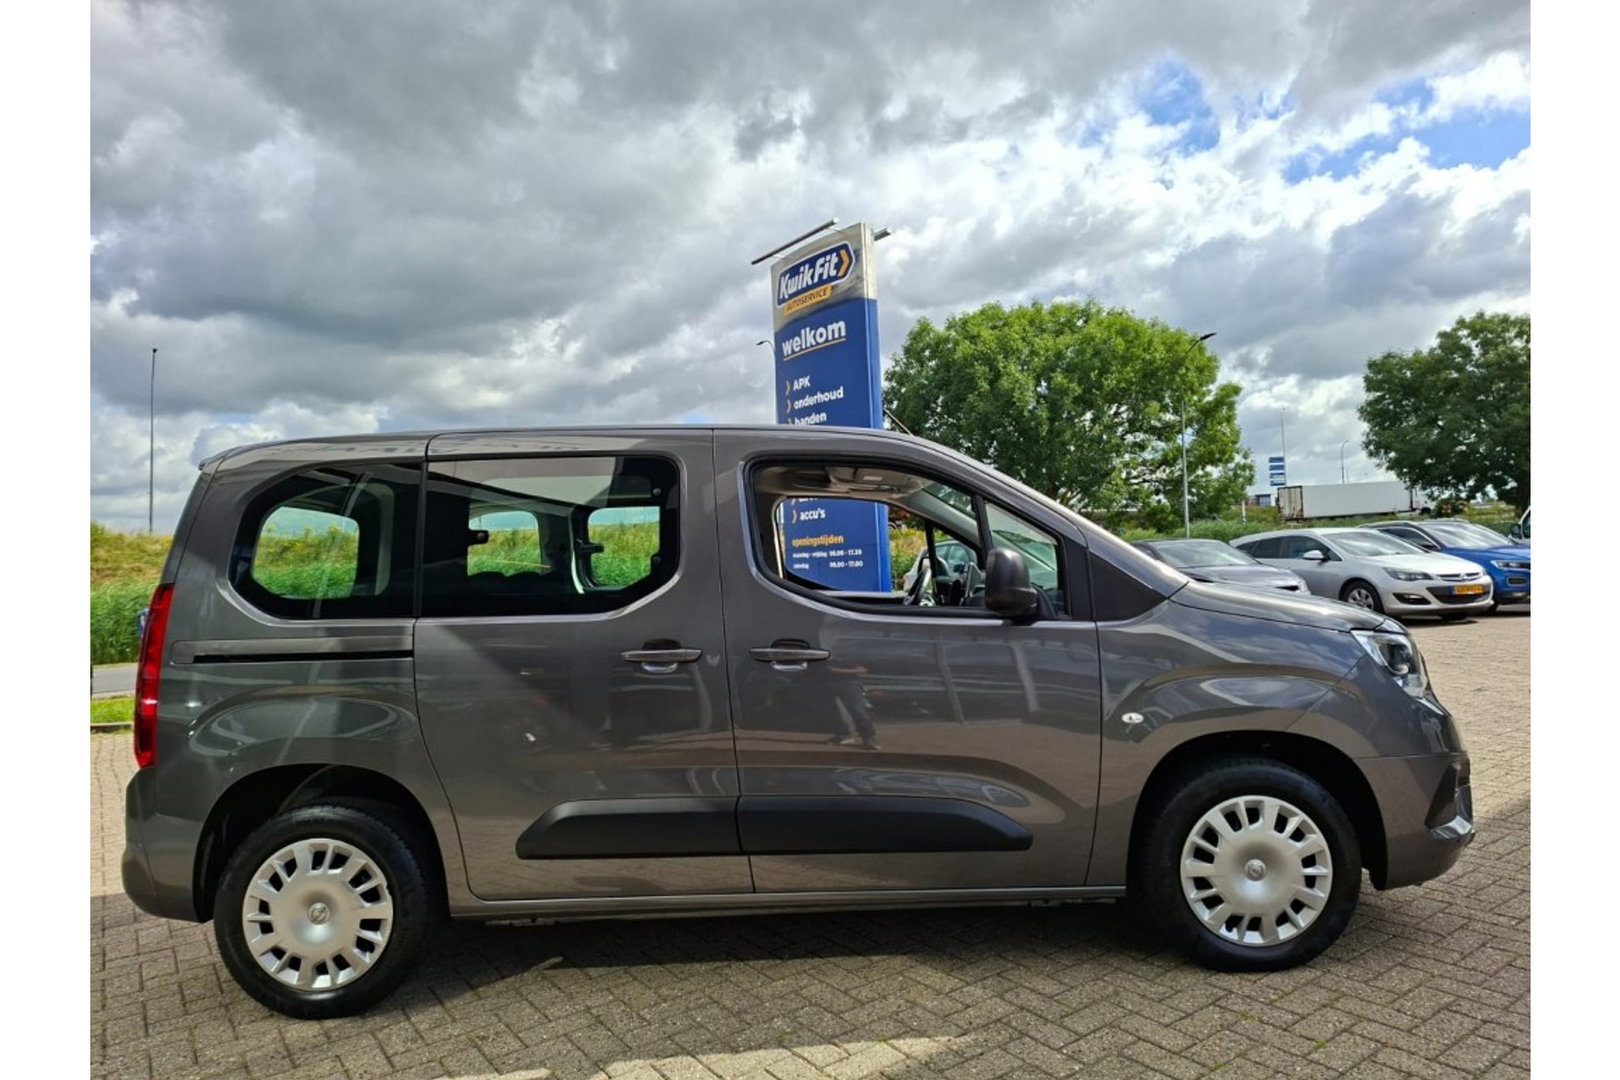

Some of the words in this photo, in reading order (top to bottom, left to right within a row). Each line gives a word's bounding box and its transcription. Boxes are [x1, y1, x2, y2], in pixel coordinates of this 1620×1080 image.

[786, 286, 828, 312] AUTOSERVICE
[782, 320, 846, 356] welkom
[793, 375, 811, 391] APK
[793, 386, 844, 410] onderhoud
[800, 507, 826, 521] accu's
[792, 535, 843, 547] openingstijden
